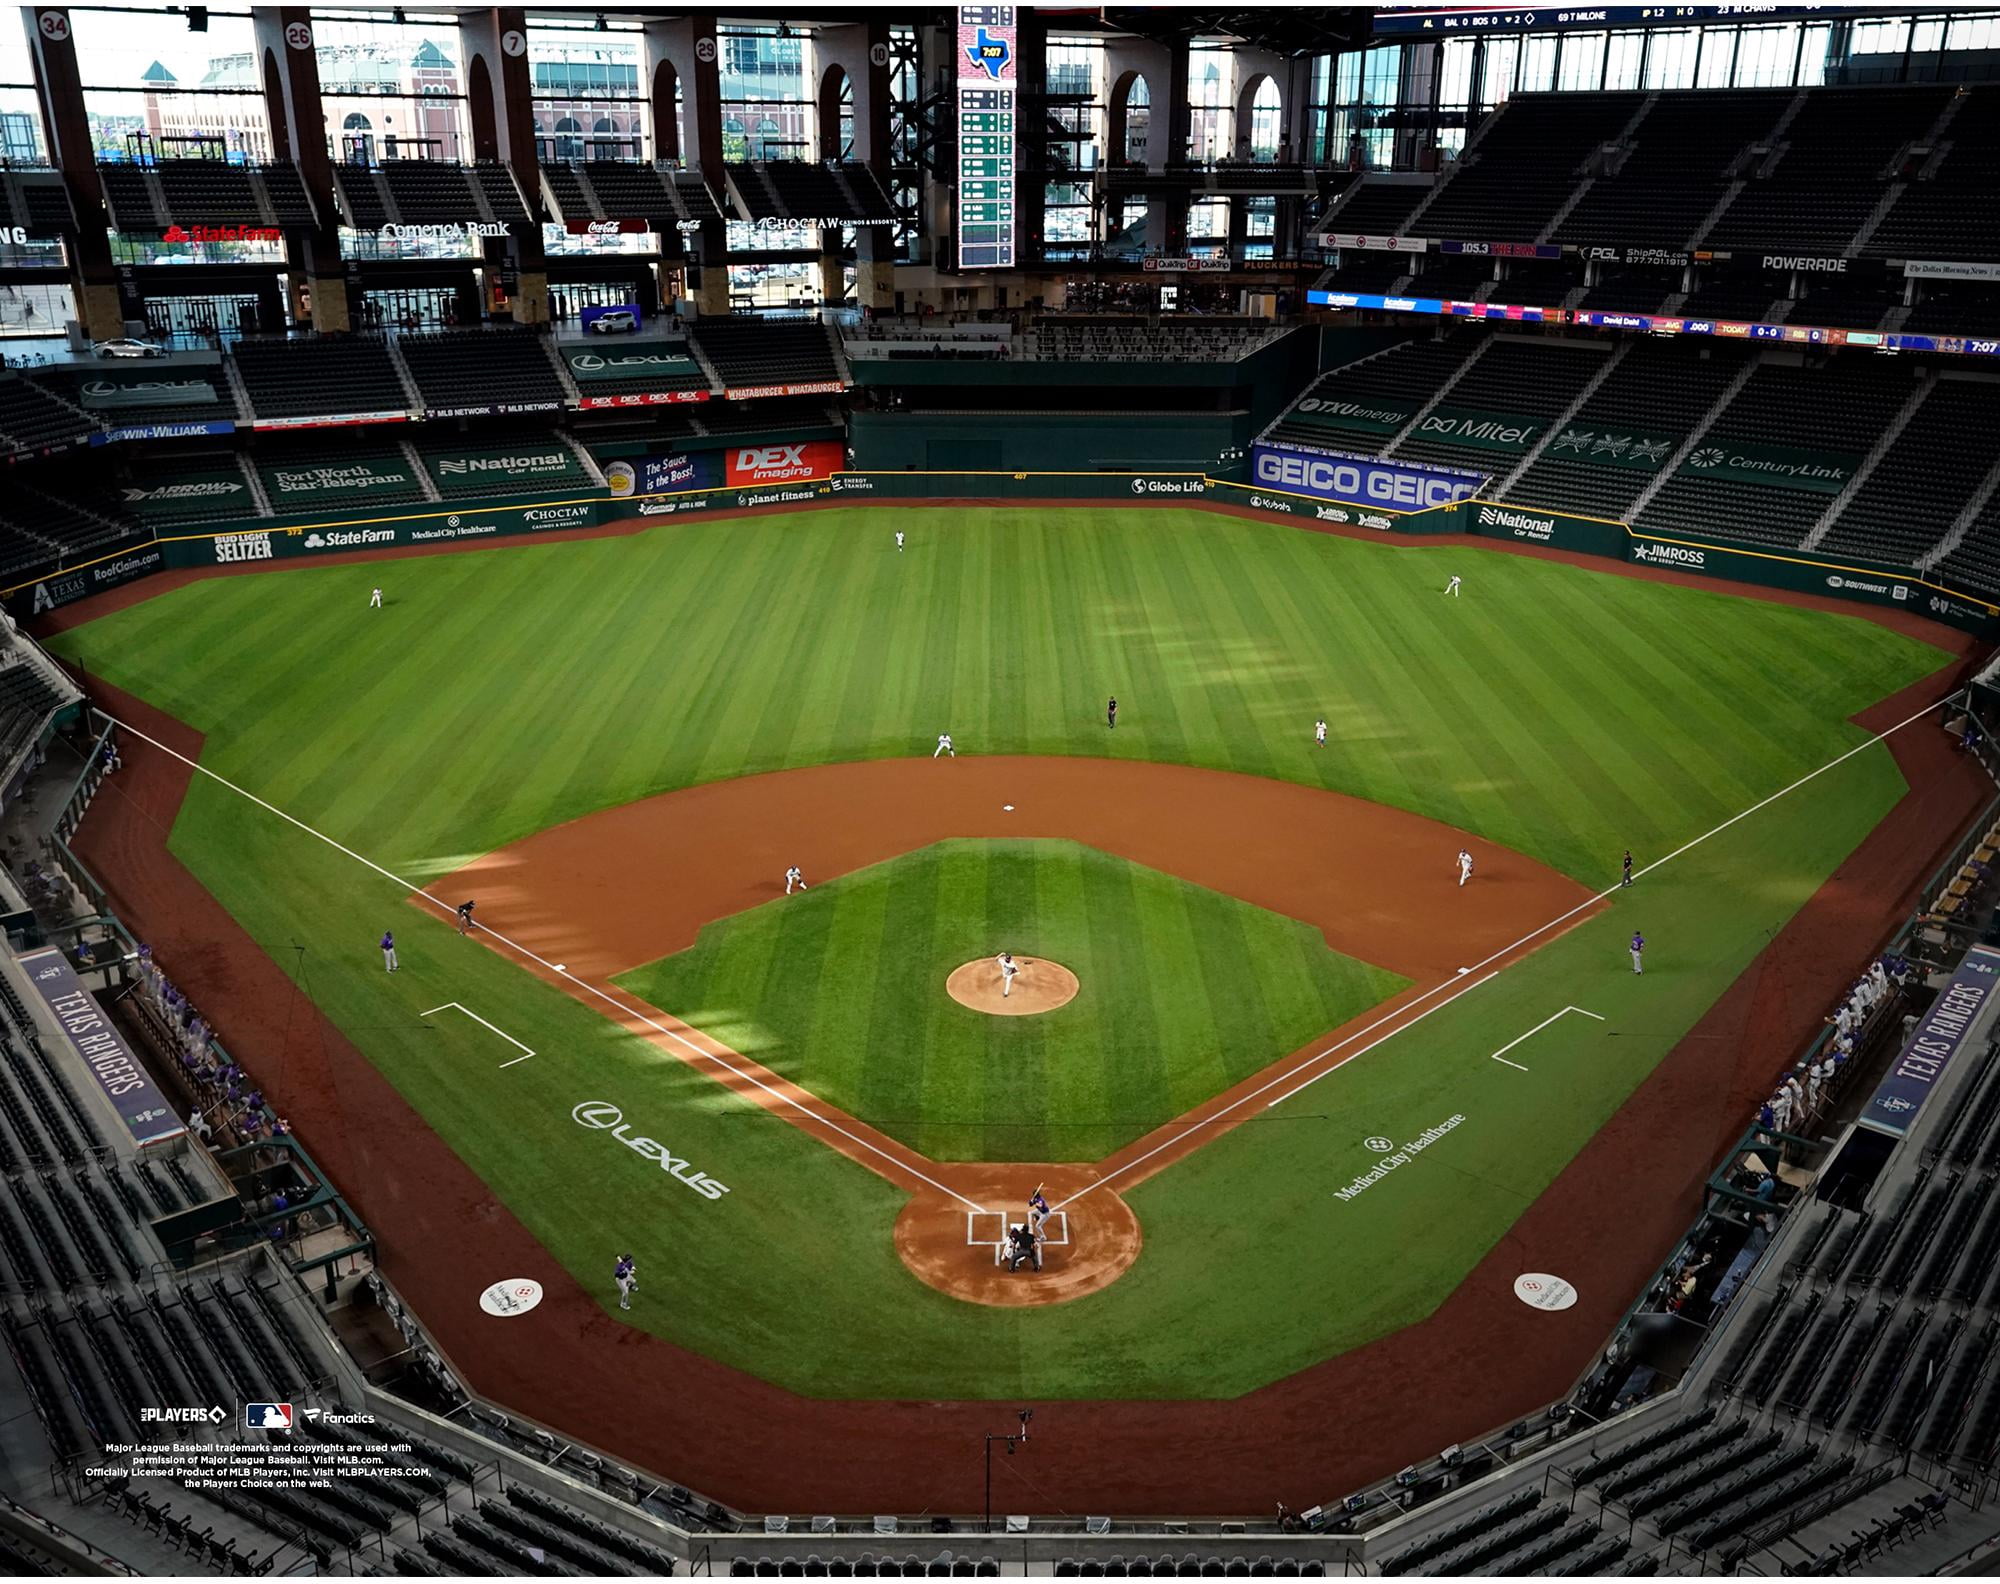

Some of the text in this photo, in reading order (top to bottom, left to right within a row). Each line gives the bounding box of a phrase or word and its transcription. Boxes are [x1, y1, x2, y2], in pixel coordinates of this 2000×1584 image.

[1558, 11, 1606, 22] 69 T MILONE
[1676, 6, 1694, 16] H 0
[40, 16, 67, 35] 34
[1423, 20, 1434, 28] AL
[1444, 18, 1468, 26] BAL 0
[1472, 16, 1498, 26] BOS 0
[1514, 16, 1520, 24] 2
[288, 28, 311, 44] 26
[508, 36, 520, 52] 7
[700, 42, 714, 58] 29
[874, 48, 886, 62] 10
[982, 47, 1002, 57] 7:07
[466, 221, 511, 236] Bank
[766, 217, 839, 230] CHOCTAW
[871, 218, 897, 226] RESORTS
[1462, 243, 1488, 254] 105.3
[1590, 248, 1620, 260] PGL
[1158, 260, 1187, 270] QuikTrip
[1201, 261, 1230, 270] QuikTrip
[1244, 262, 1298, 270] PLUCKERS
[1762, 256, 1848, 272] POWERADE
[1909, 264, 1921, 273] The
[1942, 266, 1970, 275] Morning
[1578, 314, 1589, 322] 26
[1602, 316, 1640, 326] David Dahl
[1665, 322, 1680, 330] AVG
[1722, 326, 1746, 334] TODAY
[1812, 331, 1818, 340] 0
[1972, 342, 1998, 353] 7:07
[610, 354, 690, 366] LEXUS
[120, 379, 208, 392] LEXUS
[787, 382, 840, 395] WHATABURGER
[620, 395, 641, 404] DEX
[648, 394, 669, 402] DEX
[676, 392, 697, 400] DEX
[728, 386, 784, 400] WHATABURGER
[592, 396, 612, 405] DEX
[437, 406, 490, 417] MLB NETWORK
[508, 402, 558, 413] MLB NETWORK
[1456, 419, 1534, 444] Mitel
[470, 453, 564, 472] National
[736, 445, 806, 472] DEX
[508, 464, 566, 475] Car Rental
[646, 464, 660, 476] The
[662, 455, 687, 470] Sauce
[1729, 456, 1842, 480] CenturyLink
[274, 466, 372, 482] Fort Worth
[646, 464, 694, 490] is the Boss!
[753, 466, 812, 480] imaging
[1258, 454, 1360, 494] GEICO
[152, 482, 225, 494] ARROW
[278, 474, 406, 492] Star-Telegram
[1148, 480, 1204, 493] Globe Life
[748, 490, 814, 506] planet fitness
[1262, 498, 1292, 512] Kubota
[531, 507, 589, 520] CHOCTAW
[560, 520, 582, 528] RESORTS
[1496, 510, 1554, 532] National
[214, 532, 270, 544] BUD LIGHT
[287, 528, 303, 536] 372
[412, 524, 496, 540] Medical City Healthcare
[1514, 528, 1550, 540] Car Rental
[215, 540, 273, 562] SELTZER
[94, 552, 160, 582] RoofClaim.com
[52, 578, 86, 598] TEXAS
[1844, 580, 1888, 594] SOUTHWEST
[1896, 983, 1985, 1082] TEXAS RANGERS
[51, 990, 144, 1096] TEXAS RANGERS
[612, 1124, 730, 1200] LEXUS
[1333, 1113, 1466, 1202] Medical City Healthcare
